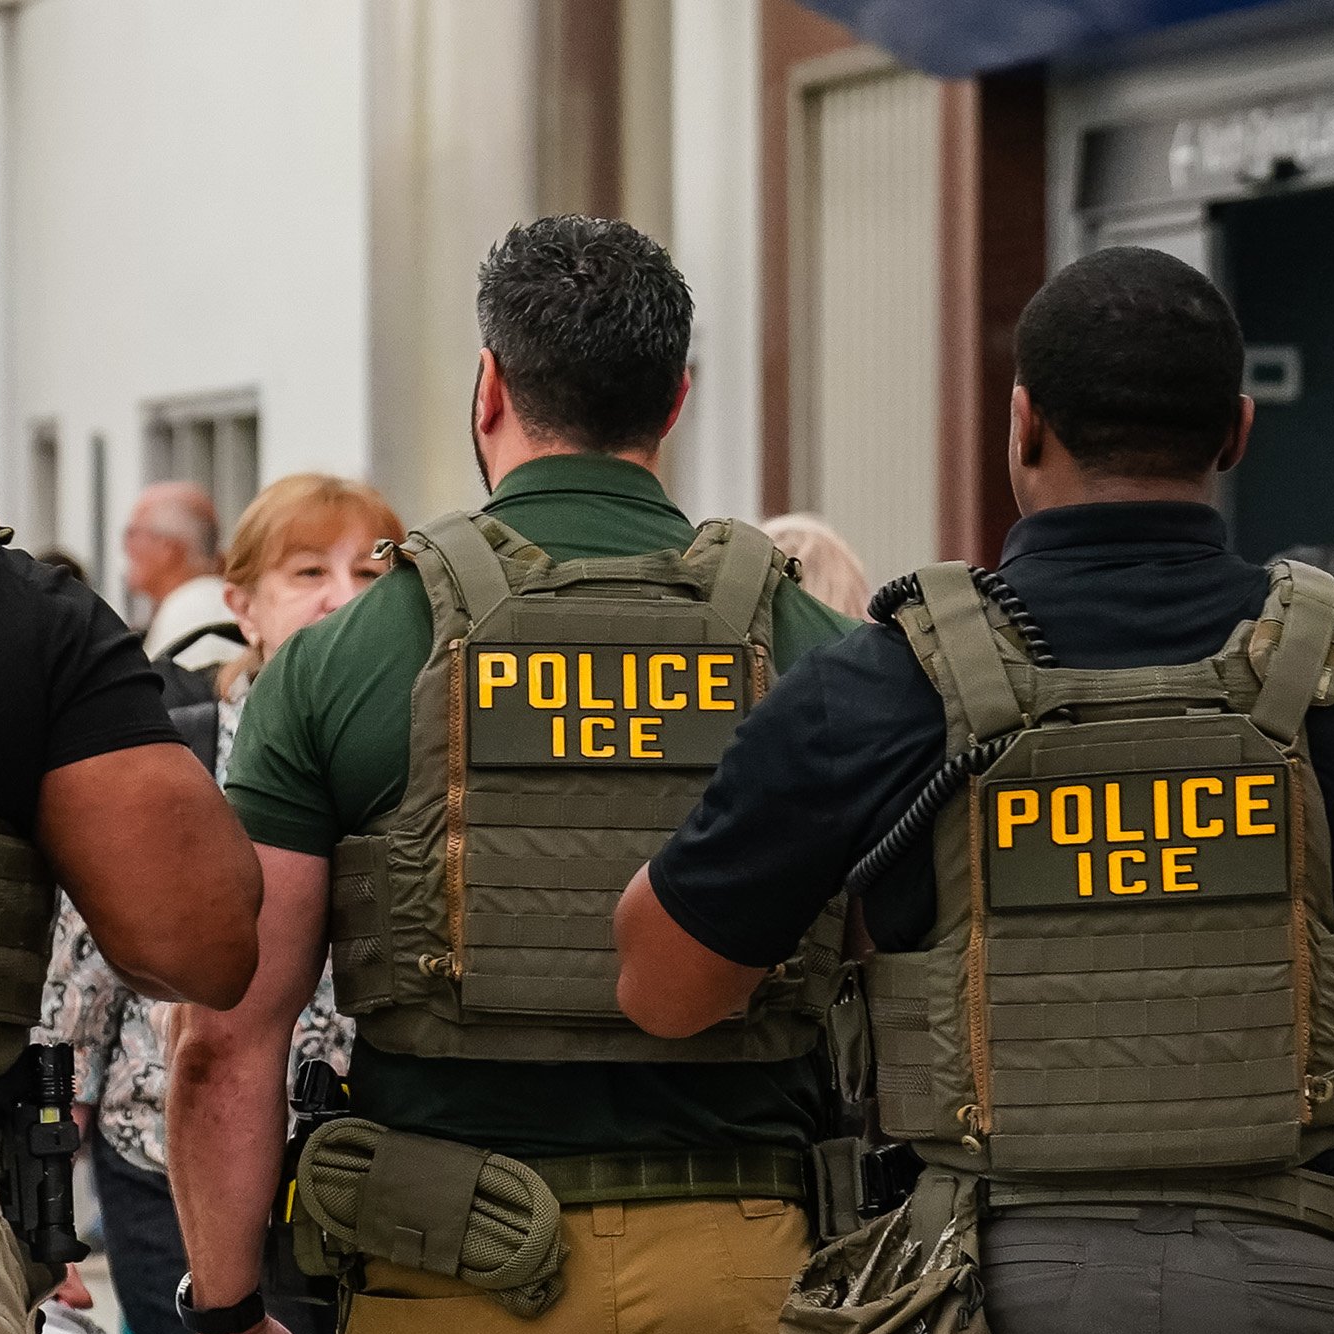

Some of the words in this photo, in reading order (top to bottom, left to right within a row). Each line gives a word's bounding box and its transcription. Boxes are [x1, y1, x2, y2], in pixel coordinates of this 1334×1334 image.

[478, 652, 735, 710] POLICE
[552, 716, 663, 758] ICE
[997, 775, 1276, 848] POLICE
[1077, 847, 1199, 897] ICE
